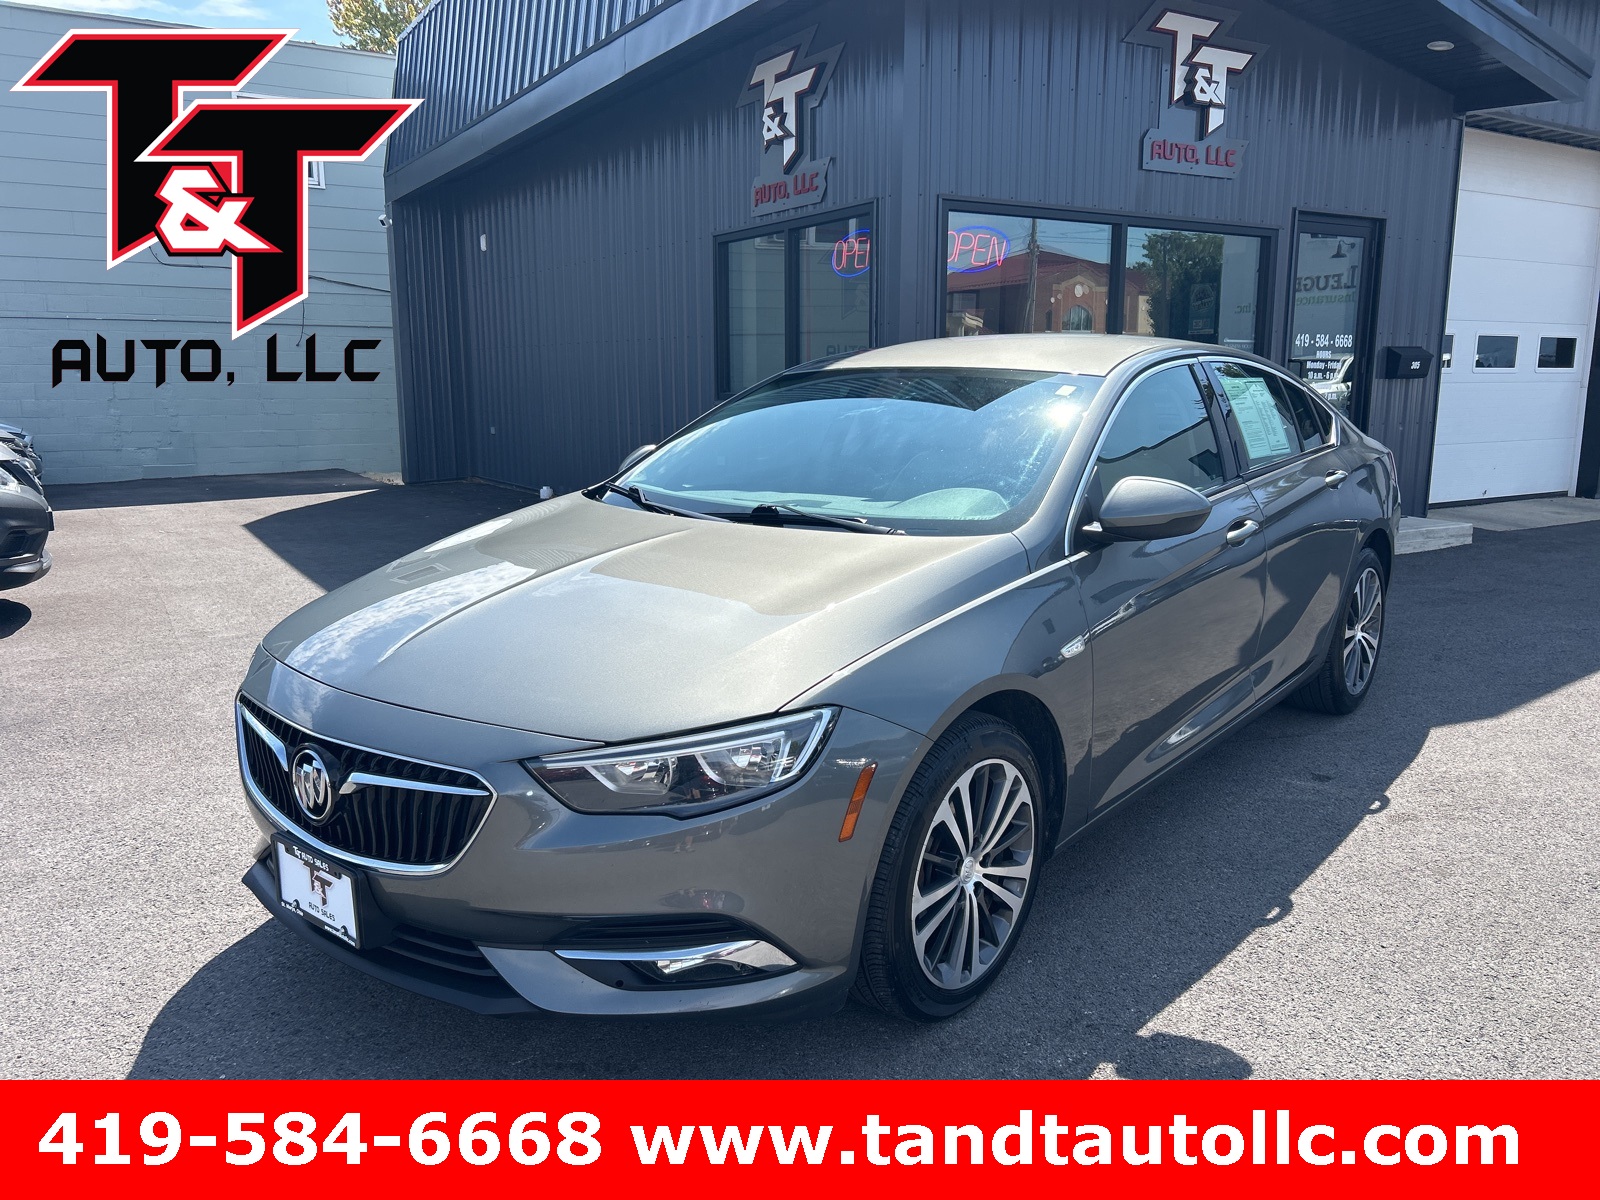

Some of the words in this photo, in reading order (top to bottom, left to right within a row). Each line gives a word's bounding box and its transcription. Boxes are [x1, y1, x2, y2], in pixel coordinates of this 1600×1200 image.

[1151, 139, 1200, 165] AUTO,
[1206, 144, 1237, 168] LLC
[754, 181, 790, 207] AUTO,
[793, 171, 819, 196] LLC
[1295, 333, 1310, 347] 419
[1315, 334, 1329, 347] 584
[1334, 334, 1353, 348] 6668
[1306, 360, 1325, 370] Monday
[313, 857, 330, 872] SALES
[308, 901, 321, 914] AUTO
[320, 907, 336, 922] SALES
